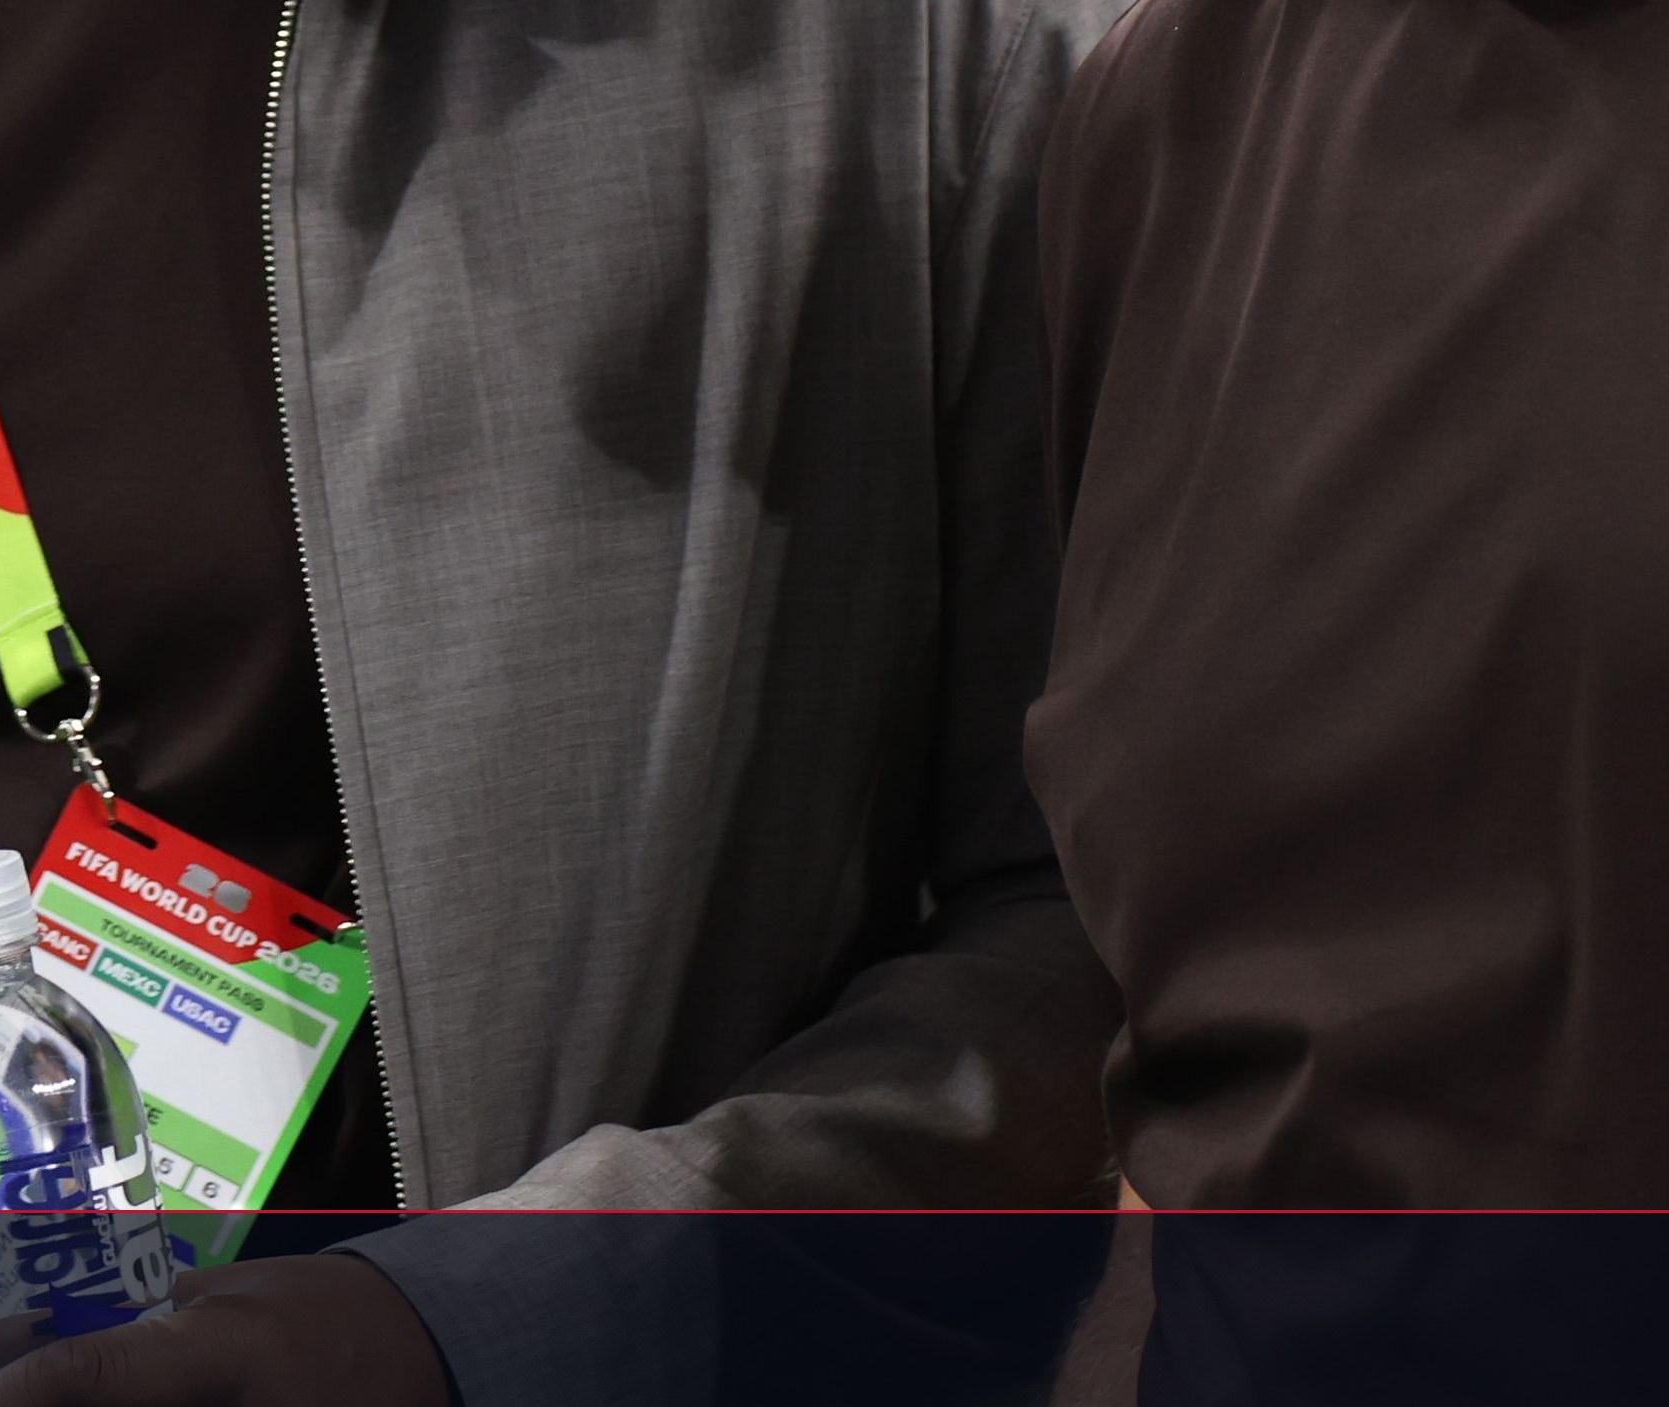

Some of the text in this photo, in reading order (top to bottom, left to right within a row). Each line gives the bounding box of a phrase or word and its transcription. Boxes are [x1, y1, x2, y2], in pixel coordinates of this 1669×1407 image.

[65, 842, 340, 994] FIFA WORLD CUP 2026
[98, 957, 162, 999] MEXC
[100, 917, 266, 1012] TOURNAMENT PASS
[89, 1134, 172, 1318] art
